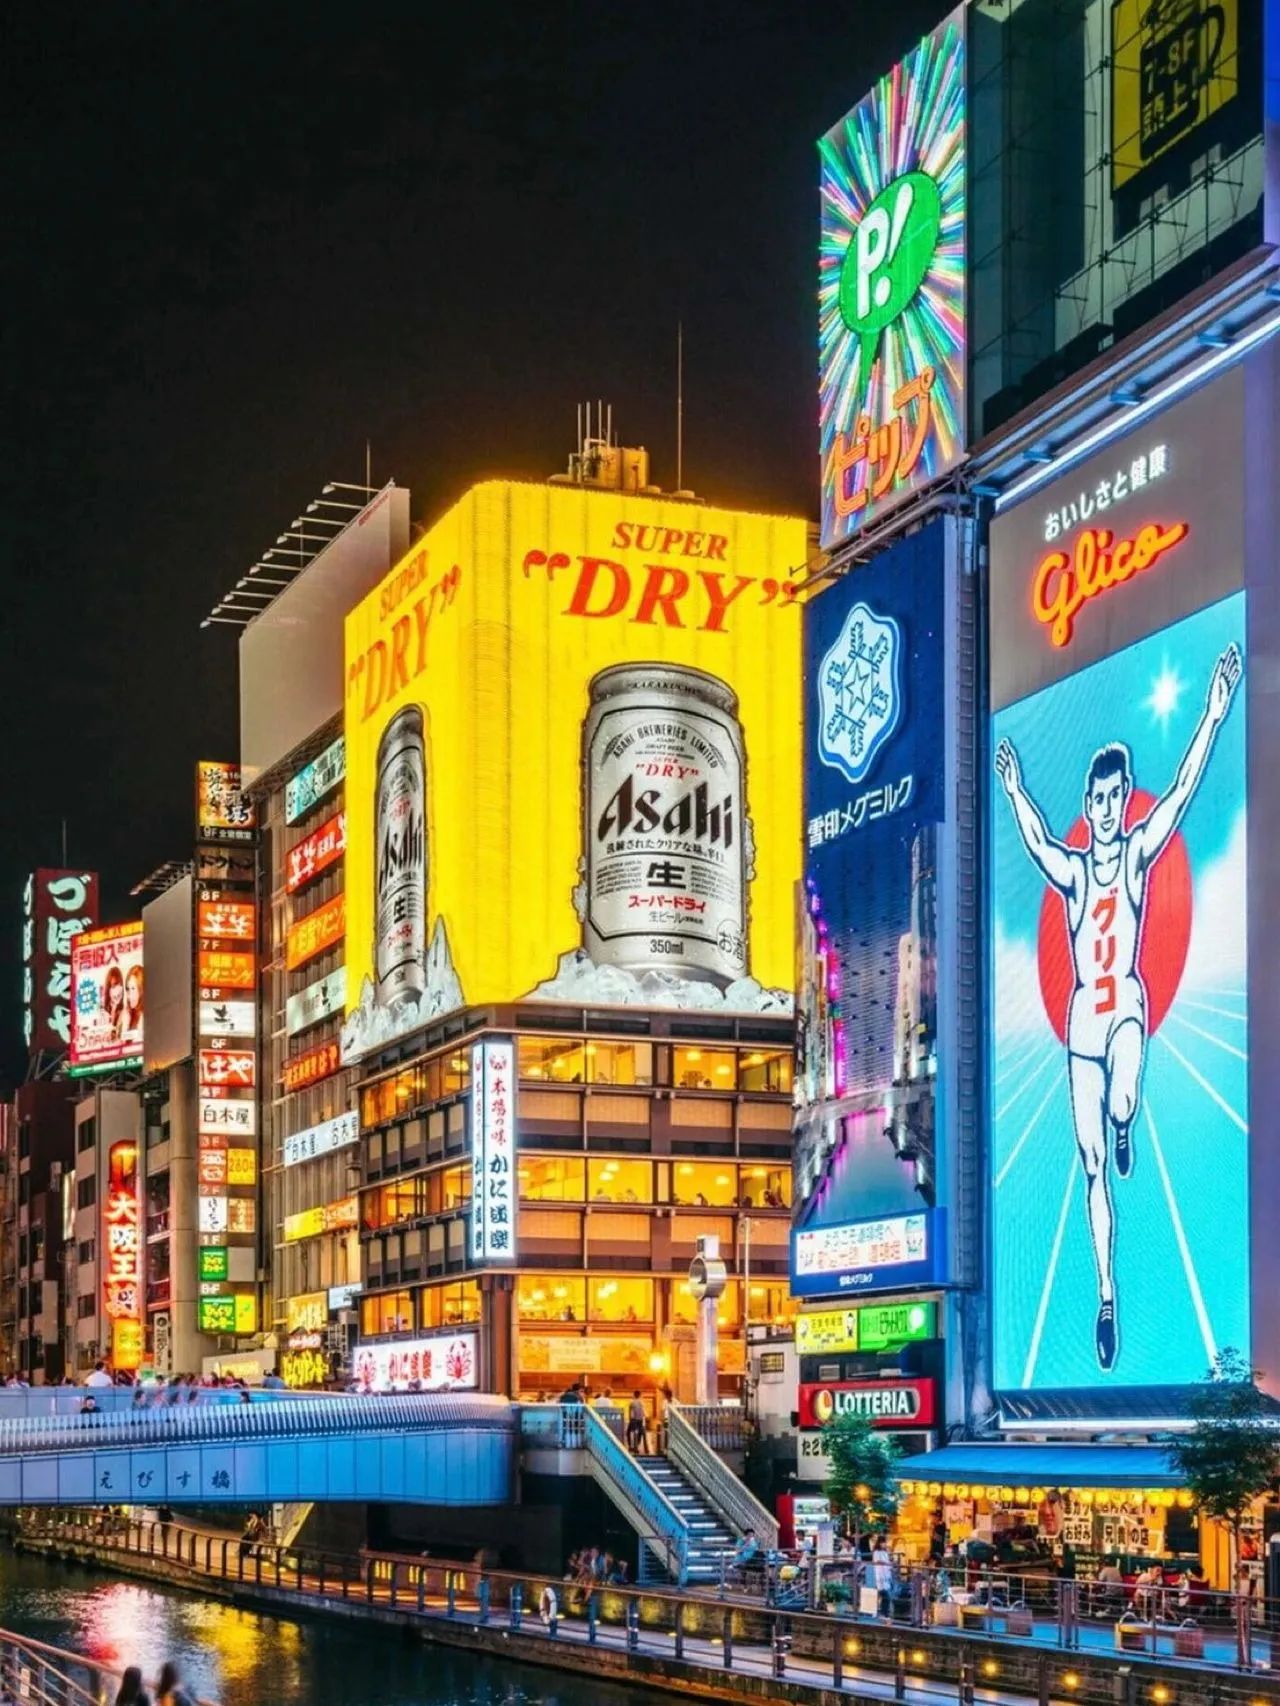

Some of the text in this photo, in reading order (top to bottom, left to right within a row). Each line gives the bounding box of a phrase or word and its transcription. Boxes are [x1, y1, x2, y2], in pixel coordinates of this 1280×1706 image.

[834, 367, 936, 517] ピップ
[1044, 444, 1168, 543] おいしさと健康
[611, 521, 729, 561] SUPER
[380, 549, 428, 622] SUPER
[1033, 522, 1189, 647] Glico
[612, 723, 719, 770] ASAHI BREWERIES LIMITED
[598, 773, 733, 849] Asahi
[808, 774, 913, 848] 雪印メグミルク
[201, 890, 220, 900] 8F
[646, 861, 687, 890] 生
[628, 895, 706, 914] スーパードライ
[201, 940, 220, 950] 7F
[1092, 886, 1118, 1015] グリコ
[201, 988, 221, 999] 6F
[203, 1104, 250, 1127] 白木屋
[489, 1152, 509, 1250] かに道楽
[103, 1192, 137, 1320] 大阪王将
[835, 1391, 909, 1415] LOTTERIA
[100, 1470, 231, 1490] えびす橋
